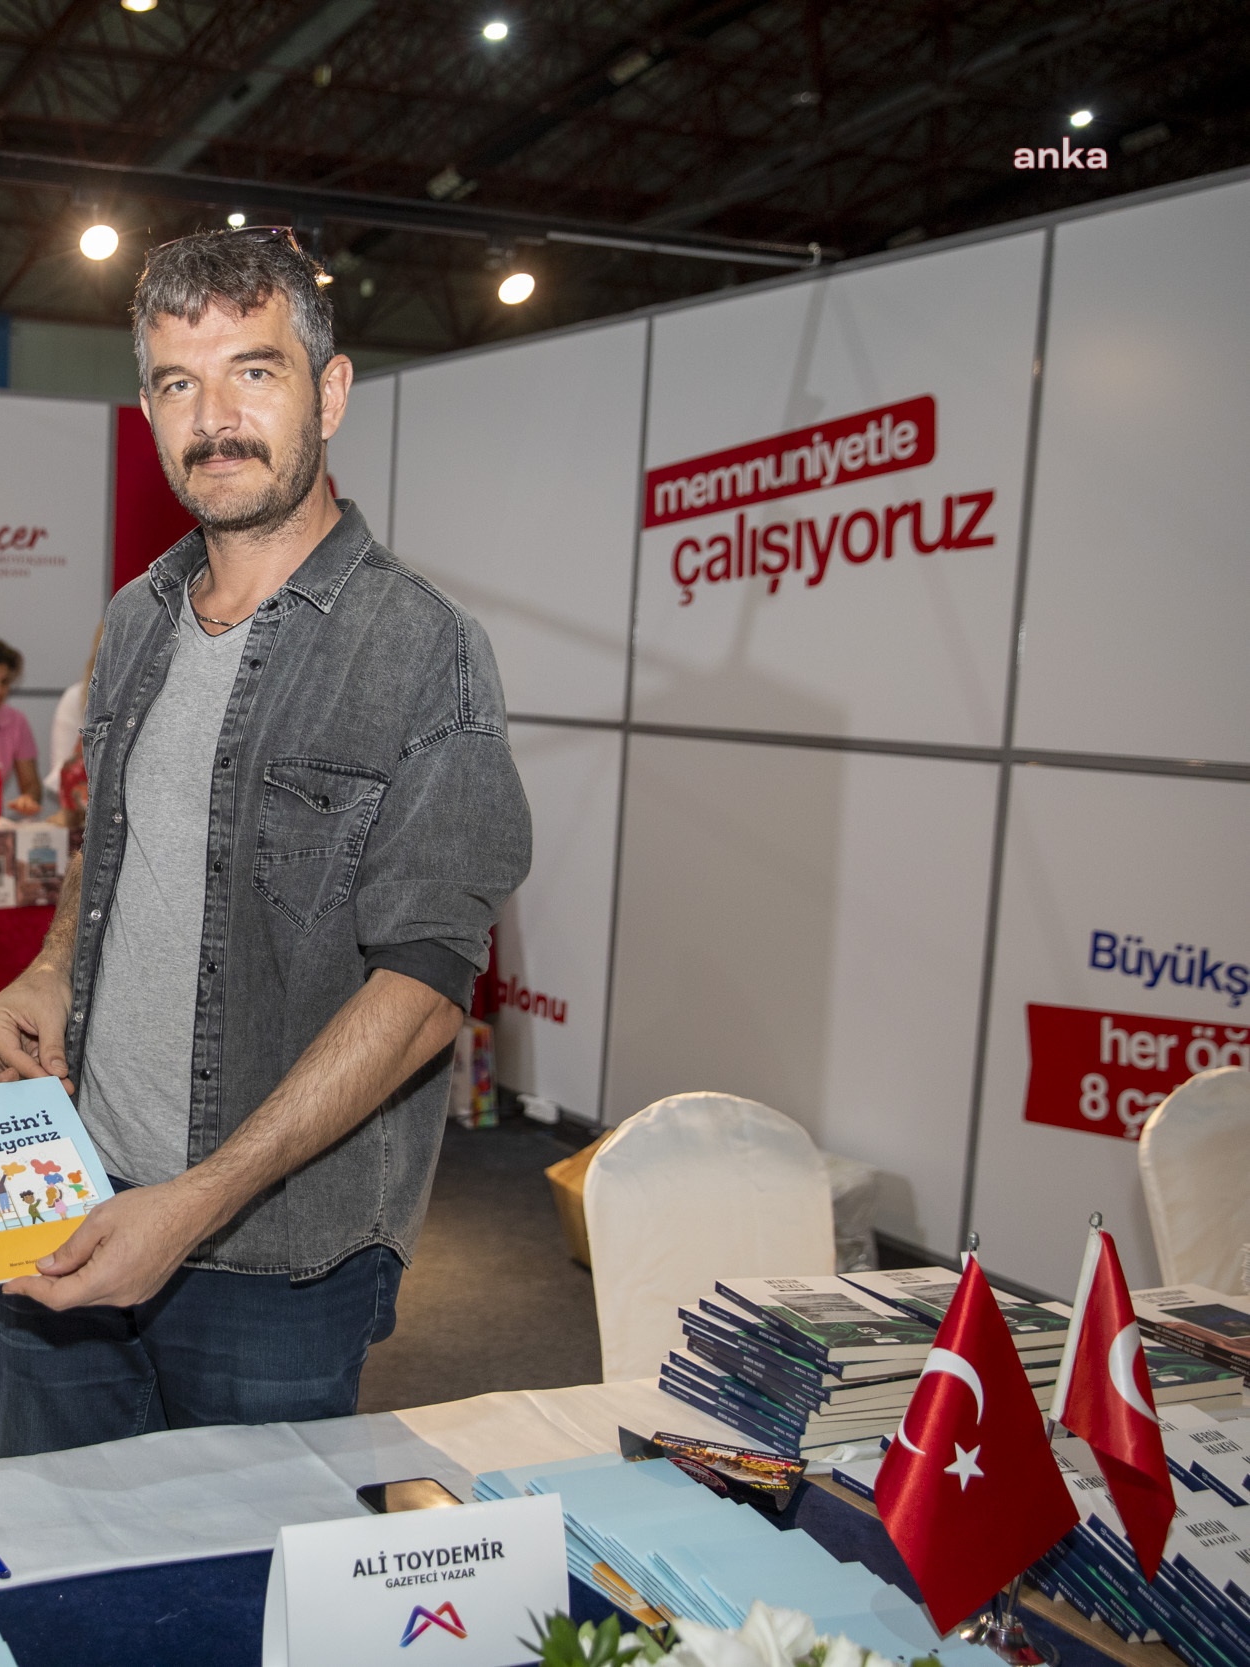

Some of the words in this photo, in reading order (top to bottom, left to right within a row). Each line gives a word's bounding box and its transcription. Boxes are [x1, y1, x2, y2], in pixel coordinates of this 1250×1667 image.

[653, 413, 919, 516] memnuniyetle
[671, 488, 996, 606] çalışıyoruz
[498, 974, 568, 1024] alonu
[1100, 1015, 1179, 1072] her
[1079, 1072, 1110, 1121] 8
[352, 1550, 388, 1578] ALİ
[393, 1537, 505, 1572] TOYDEMİR
[385, 1569, 438, 1588] GAZETECİ
[440, 1567, 476, 1581] YAZAR
